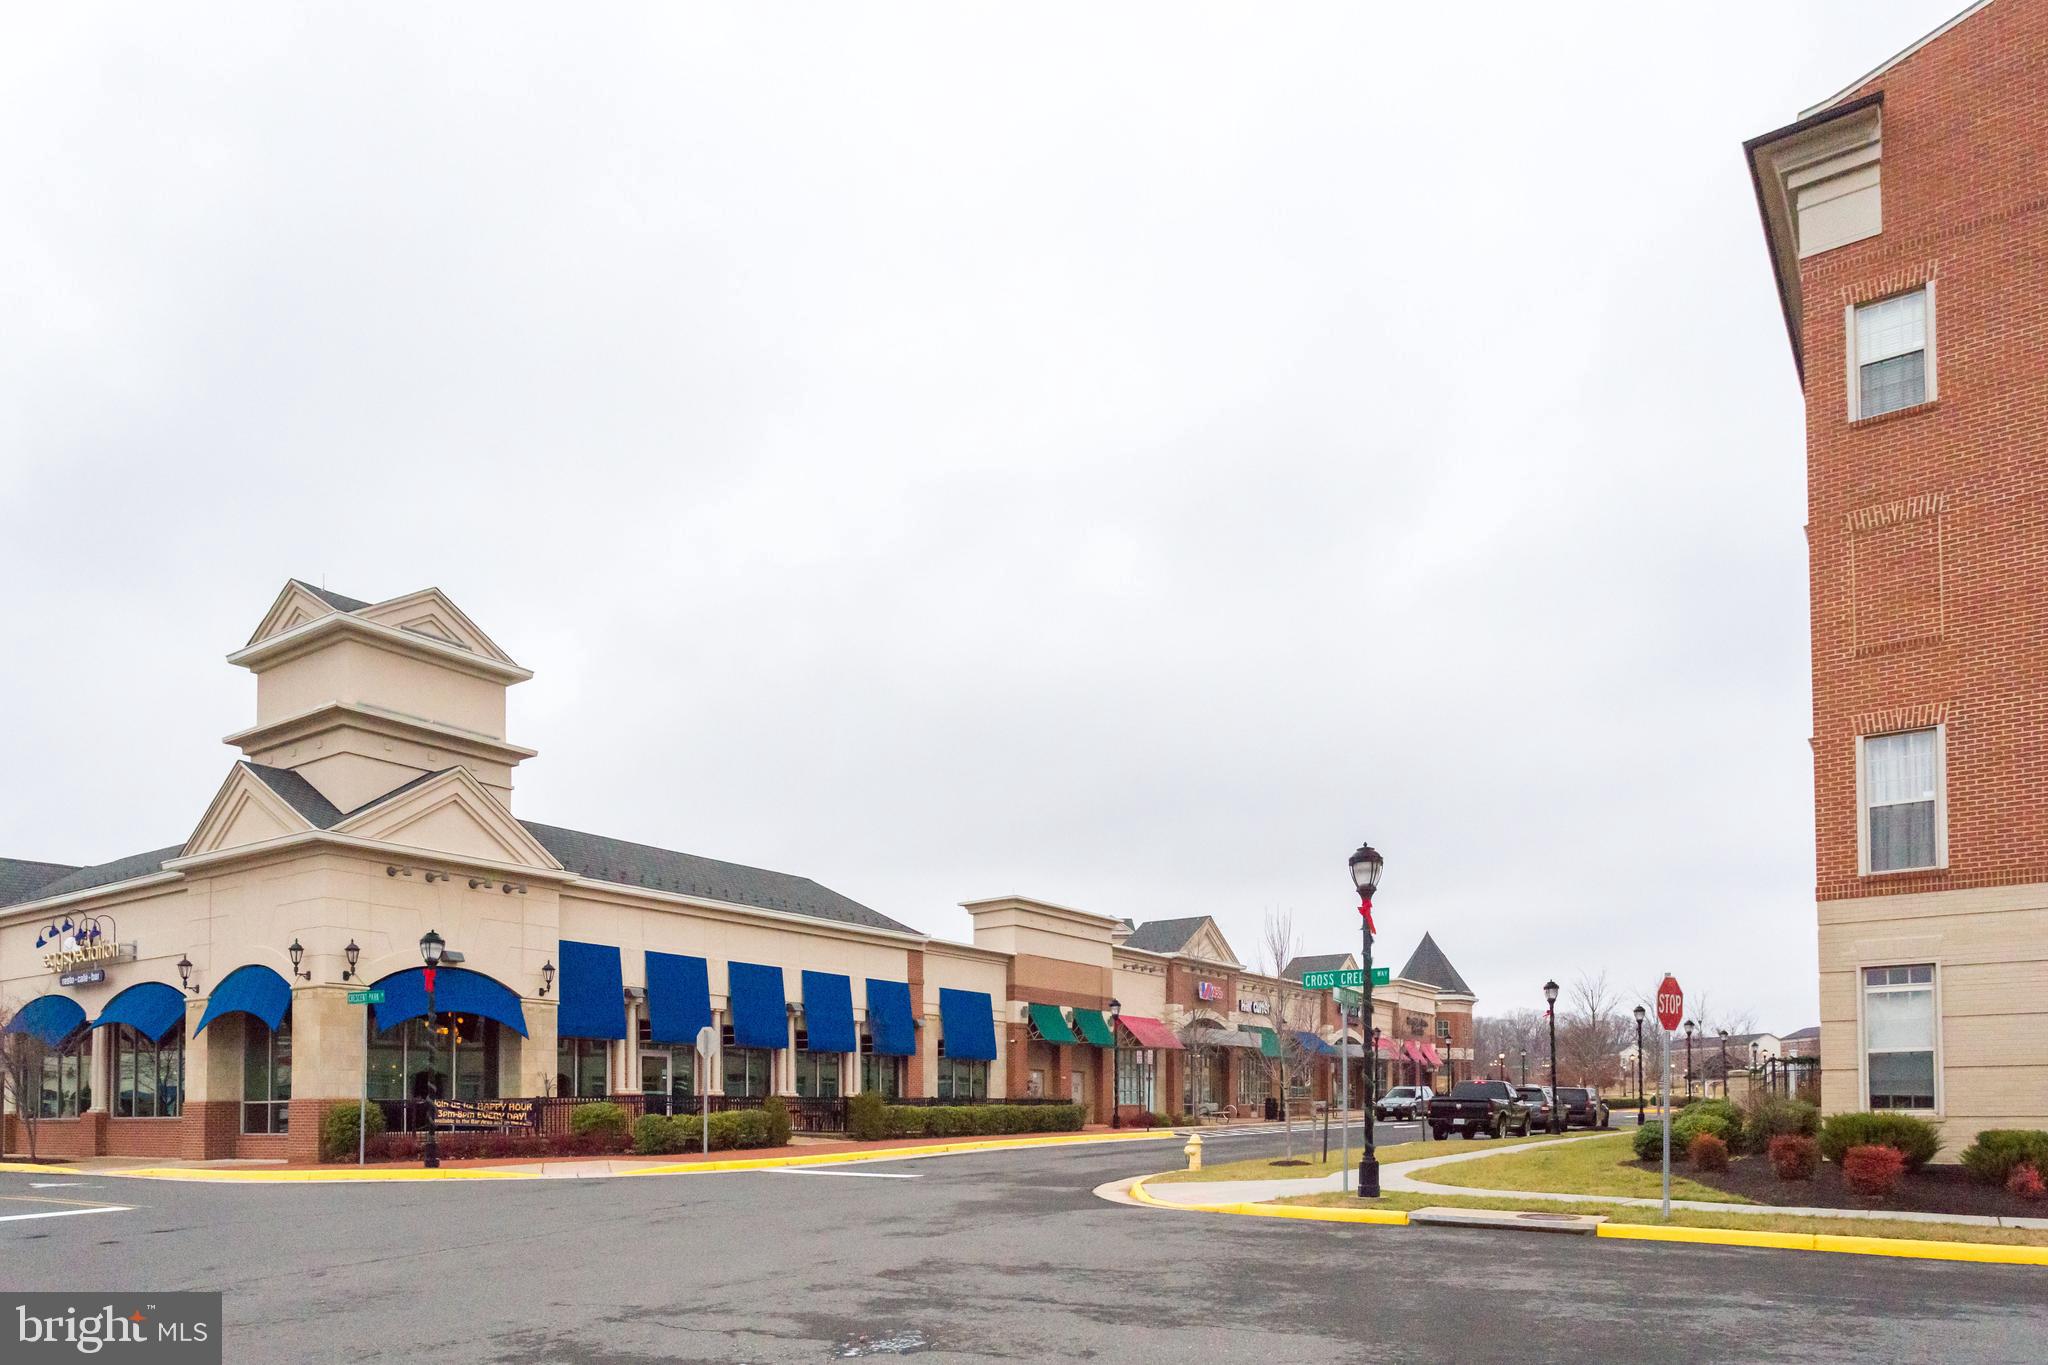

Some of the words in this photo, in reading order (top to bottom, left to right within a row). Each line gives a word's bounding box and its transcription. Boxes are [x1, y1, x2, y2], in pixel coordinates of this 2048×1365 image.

[42, 939, 120, 972] eggspectation
[1305, 973, 1334, 987] CROSS
[1341, 971, 1364, 985] CREE
[1659, 993, 1682, 1014] STOP
[477, 1102, 507, 1111] HAPPY
[508, 1103, 533, 1111] HOUR
[477, 1111, 505, 1120] EVERY
[506, 1112, 528, 1121] DAY!
